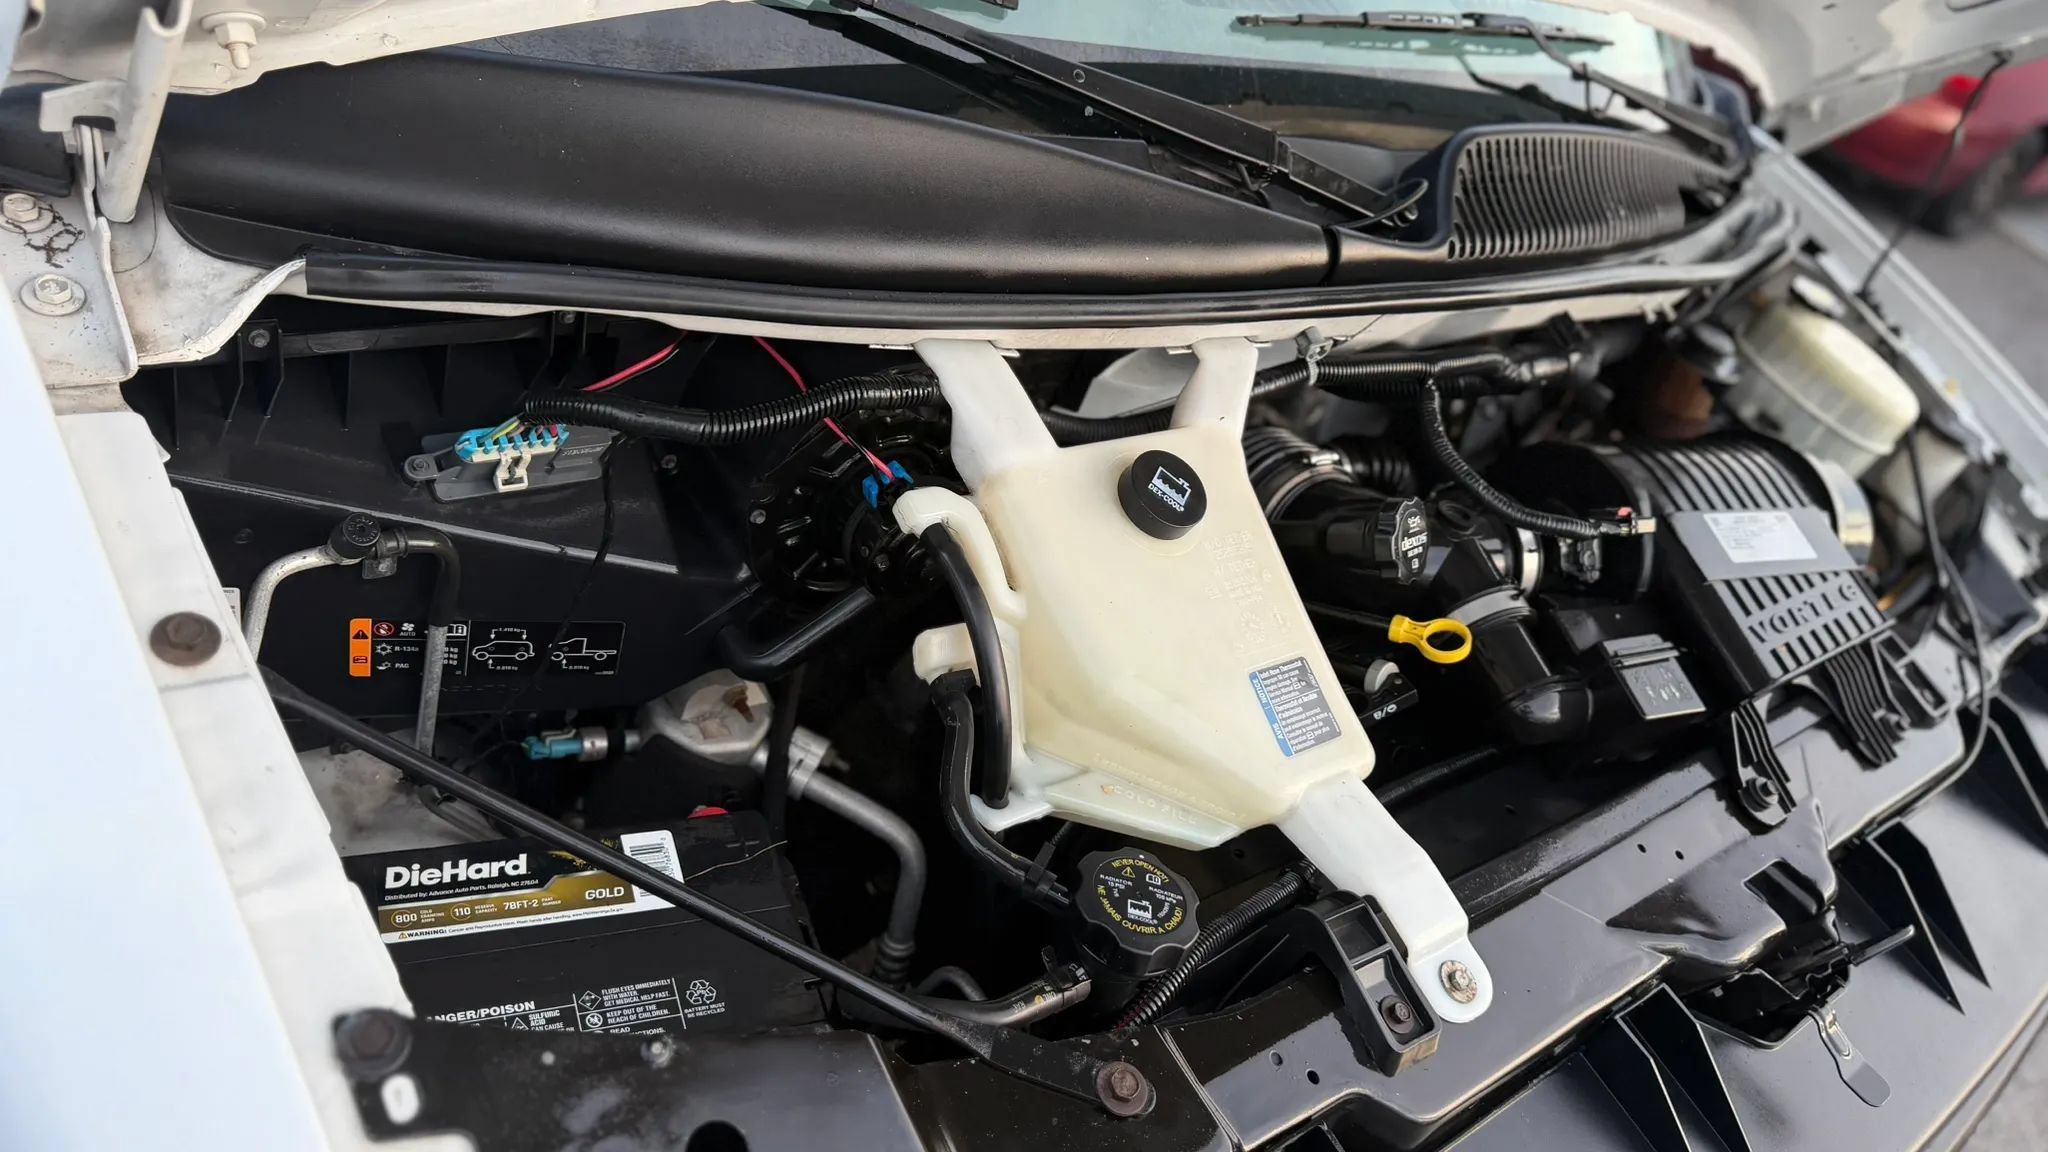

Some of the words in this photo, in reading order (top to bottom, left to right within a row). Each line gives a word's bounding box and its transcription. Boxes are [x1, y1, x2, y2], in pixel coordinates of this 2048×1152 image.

[1253, 677, 1268, 703] NOTICE
[1272, 722, 1284, 739] AVIS
[385, 853, 527, 889] DieHard
[1112, 859, 1134, 868] NEVER
[1135, 860, 1154, 872] OPEN
[1100, 874, 1133, 886] RADIATOR
[385, 892, 418, 901] Distributed
[419, 891, 428, 899] by:
[429, 889, 454, 897] Advance
[585, 886, 624, 900] GOLD
[1097, 884, 1106, 896] NE
[1148, 886, 1183, 900] RADIATEUR
[503, 899, 539, 910] 78FT-2
[1100, 896, 1122, 921] JAMAIS
[453, 907, 471, 917] 110
[1164, 906, 1183, 930] CHAUD!
[395, 913, 418, 924] 800
[1122, 919, 1157, 934] OUVRIR
[407, 929, 447, 938] WARNING:
[601, 987, 620, 995] FLUSH
[620, 984, 634, 992] EYES
[635, 979, 670, 990] IMMEDIATELY
[602, 993, 618, 1001] WITH
[616, 996, 640, 1005] MEDICAL
[640, 993, 655, 1001] HELP
[427, 1001, 535, 1022] NGER/POISON
[606, 1010, 622, 1018] KEEP
[622, 1008, 635, 1016] OUT
[635, 1006, 644, 1014] OF
[645, 1004, 657, 1012] THE
[684, 1005, 709, 1014] BATTERY
[710, 1002, 725, 1010] MUST
[695, 1007, 725, 1017] RECYCLED
[529, 1010, 560, 1020] SULFURIC
[607, 1015, 629, 1024] REACH
[530, 1018, 546, 1026] ACID
[544, 1022, 564, 1030] CAUSE
